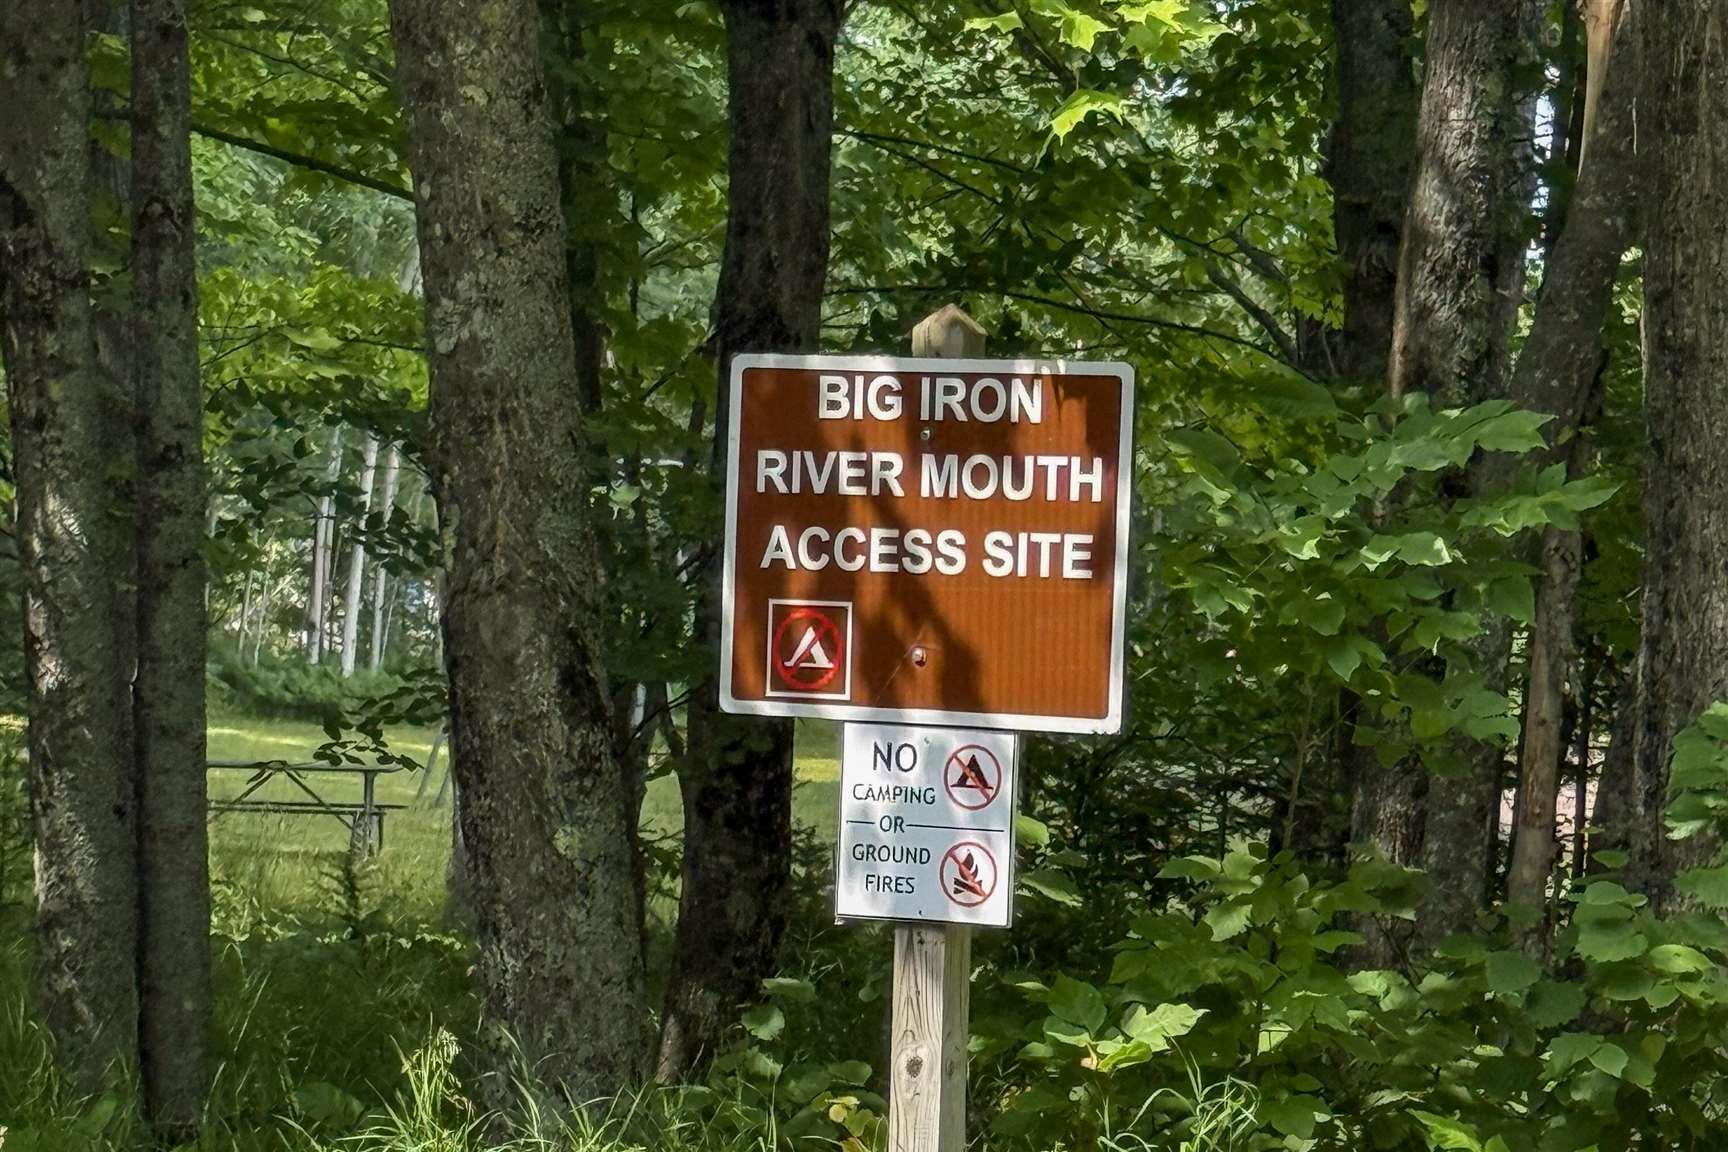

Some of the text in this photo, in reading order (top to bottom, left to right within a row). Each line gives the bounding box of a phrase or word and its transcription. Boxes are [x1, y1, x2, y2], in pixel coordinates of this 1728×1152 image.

[818, 375, 1042, 424] BIG IRON
[756, 450, 1103, 502] RIVER MOUTH
[760, 525, 1094, 579] ACCESS SITE
[872, 741, 918, 773] NO
[852, 783, 936, 805] CAMPING
[879, 815, 905, 833] OR
[852, 843, 931, 865] GROUND
[865, 874, 915, 894] FIRES
